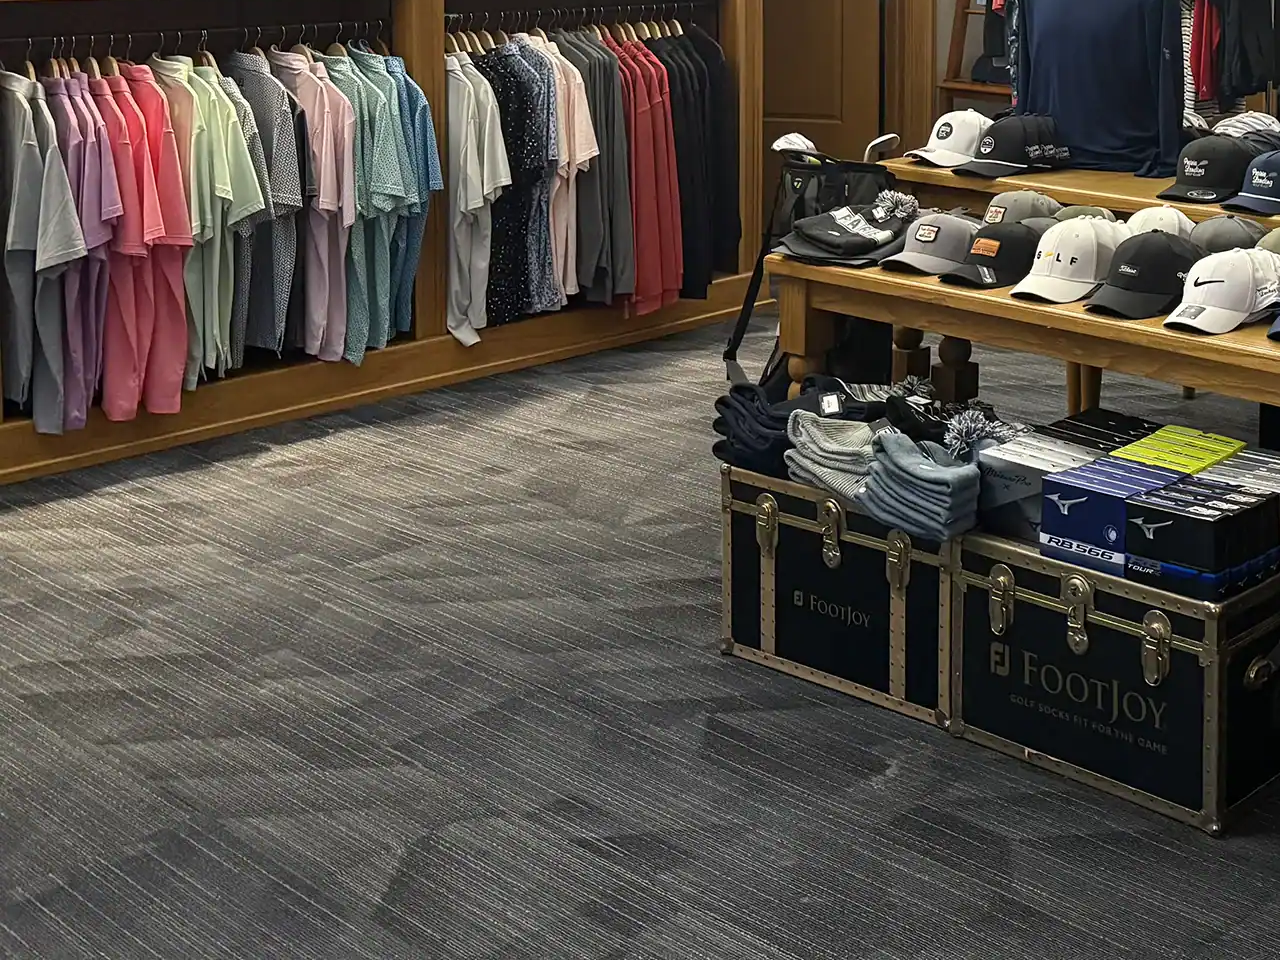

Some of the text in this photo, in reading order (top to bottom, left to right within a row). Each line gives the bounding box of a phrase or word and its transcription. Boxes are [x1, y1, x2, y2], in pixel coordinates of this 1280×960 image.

[1048, 537, 1115, 561] RB 566
[1127, 563, 1154, 575] TOUR
[1009, 692, 1035, 709] GOLF
[1038, 702, 1071, 722] SOCKS
[1073, 714, 1089, 729] FIT
